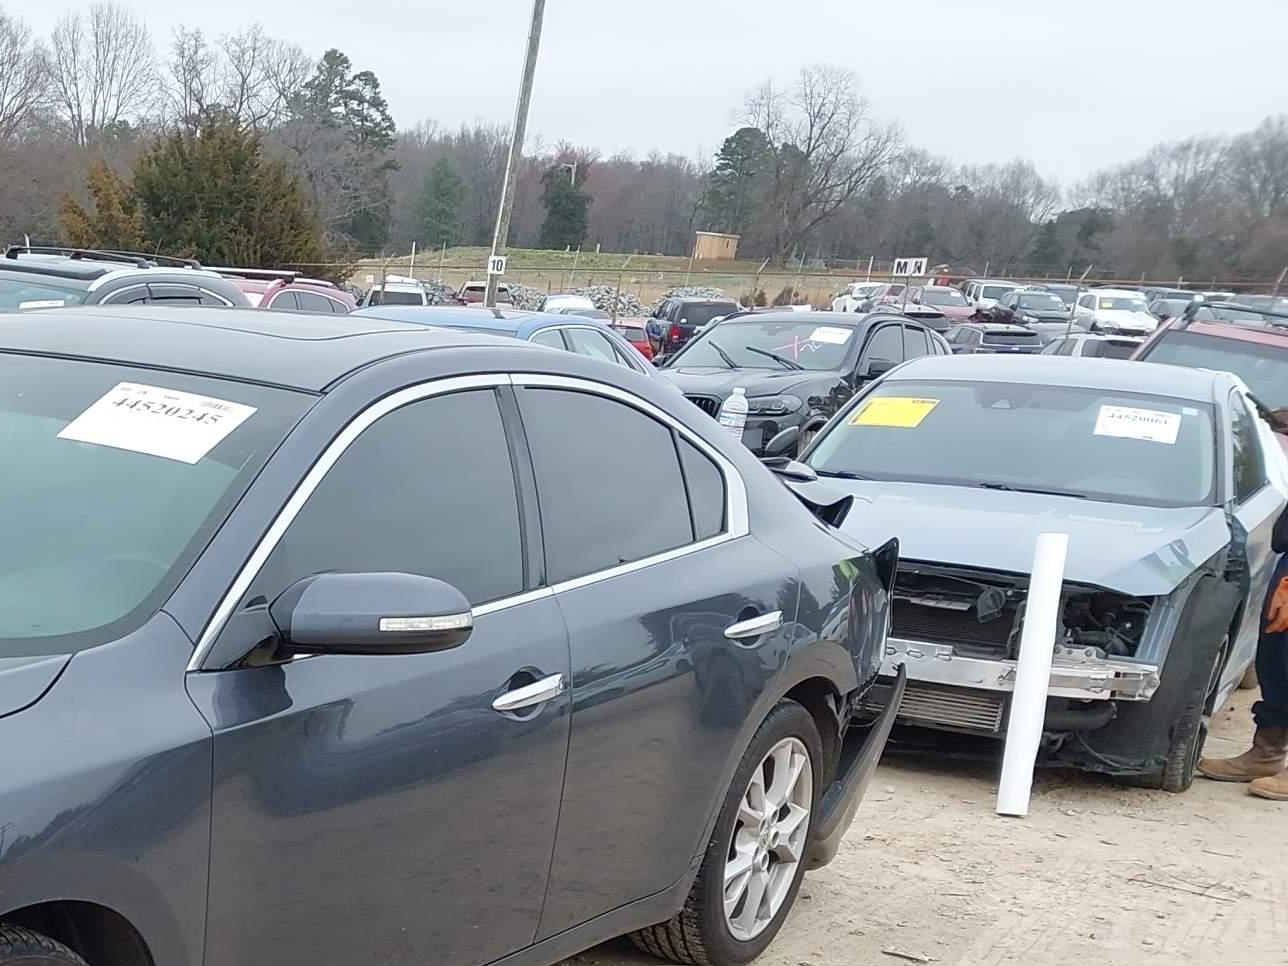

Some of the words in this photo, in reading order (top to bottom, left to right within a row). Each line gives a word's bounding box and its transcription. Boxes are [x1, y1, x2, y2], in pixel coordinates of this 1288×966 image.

[491, 259, 504, 271] 10
[895, 261, 909, 274] M
[112, 397, 224, 425] 44520245
